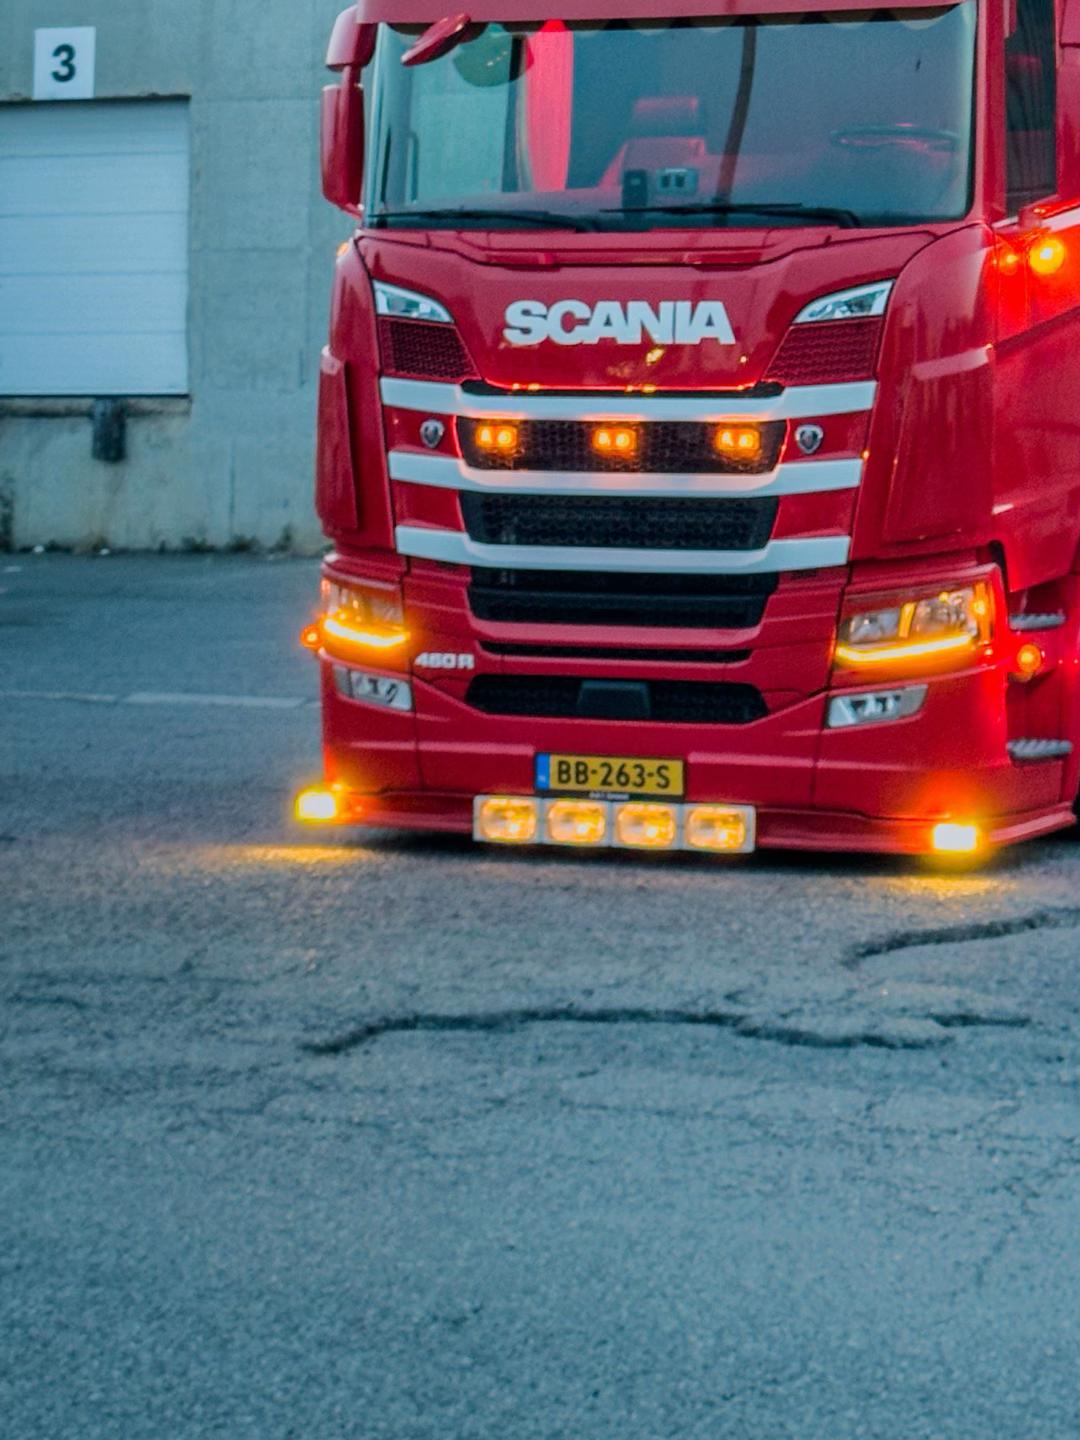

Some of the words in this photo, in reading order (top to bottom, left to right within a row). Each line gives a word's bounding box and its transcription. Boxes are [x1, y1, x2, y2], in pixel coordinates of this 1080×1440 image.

[51, 43, 76, 83] 3
[502, 299, 737, 346] SCANIA
[557, 760, 671, 789] BB-263-S
